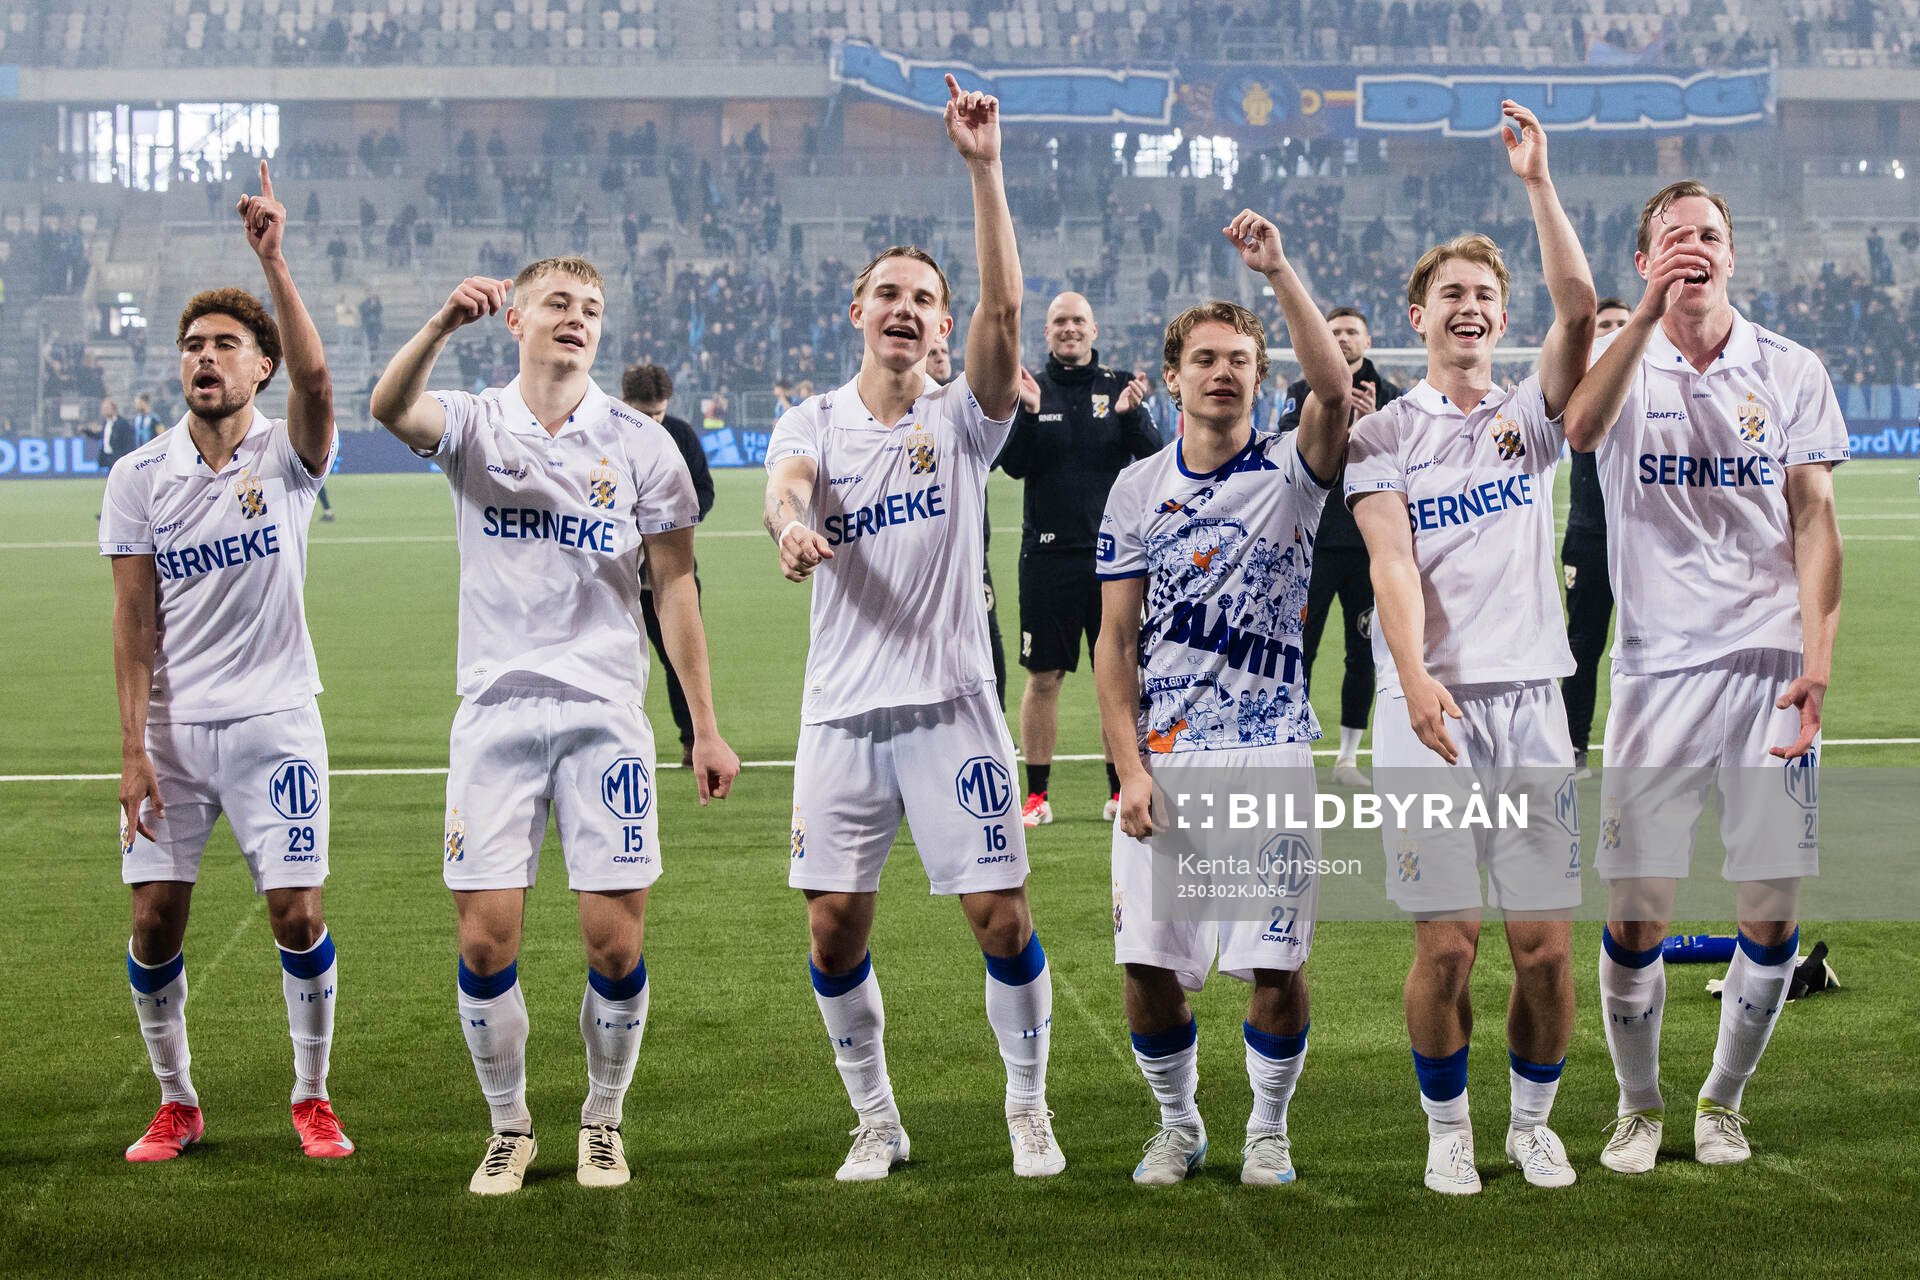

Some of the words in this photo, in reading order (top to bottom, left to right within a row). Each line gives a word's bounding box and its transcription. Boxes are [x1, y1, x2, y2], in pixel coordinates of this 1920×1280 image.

[610, 408, 643, 428] FAMECO
[1646, 411, 1679, 419] CRAFT
[1807, 451, 1826, 460] IFK
[487, 464, 519, 479] CRAFT
[830, 477, 854, 486] RAFT
[1639, 454, 1775, 487] SERNEKE
[825, 485, 946, 546] SERNEKE
[483, 506, 614, 553] SERNEKE
[1039, 533, 1056, 544] KP
[116, 544, 134, 553] IFK
[156, 525, 280, 580] SERNEKE
[273, 765, 319, 814] MG
[607, 763, 649, 814] MG
[961, 761, 1010, 813] MG
[288, 826, 315, 853] 29
[622, 825, 643, 853] 15
[983, 824, 1007, 853] 16
[283, 854, 315, 863] CRAFT
[613, 855, 645, 864] CRAFT
[977, 855, 1009, 864] CRAFT
[1569, 841, 1581, 869] 2
[1269, 905, 1299, 934] 27
[1261, 933, 1293, 944] CRAFT
